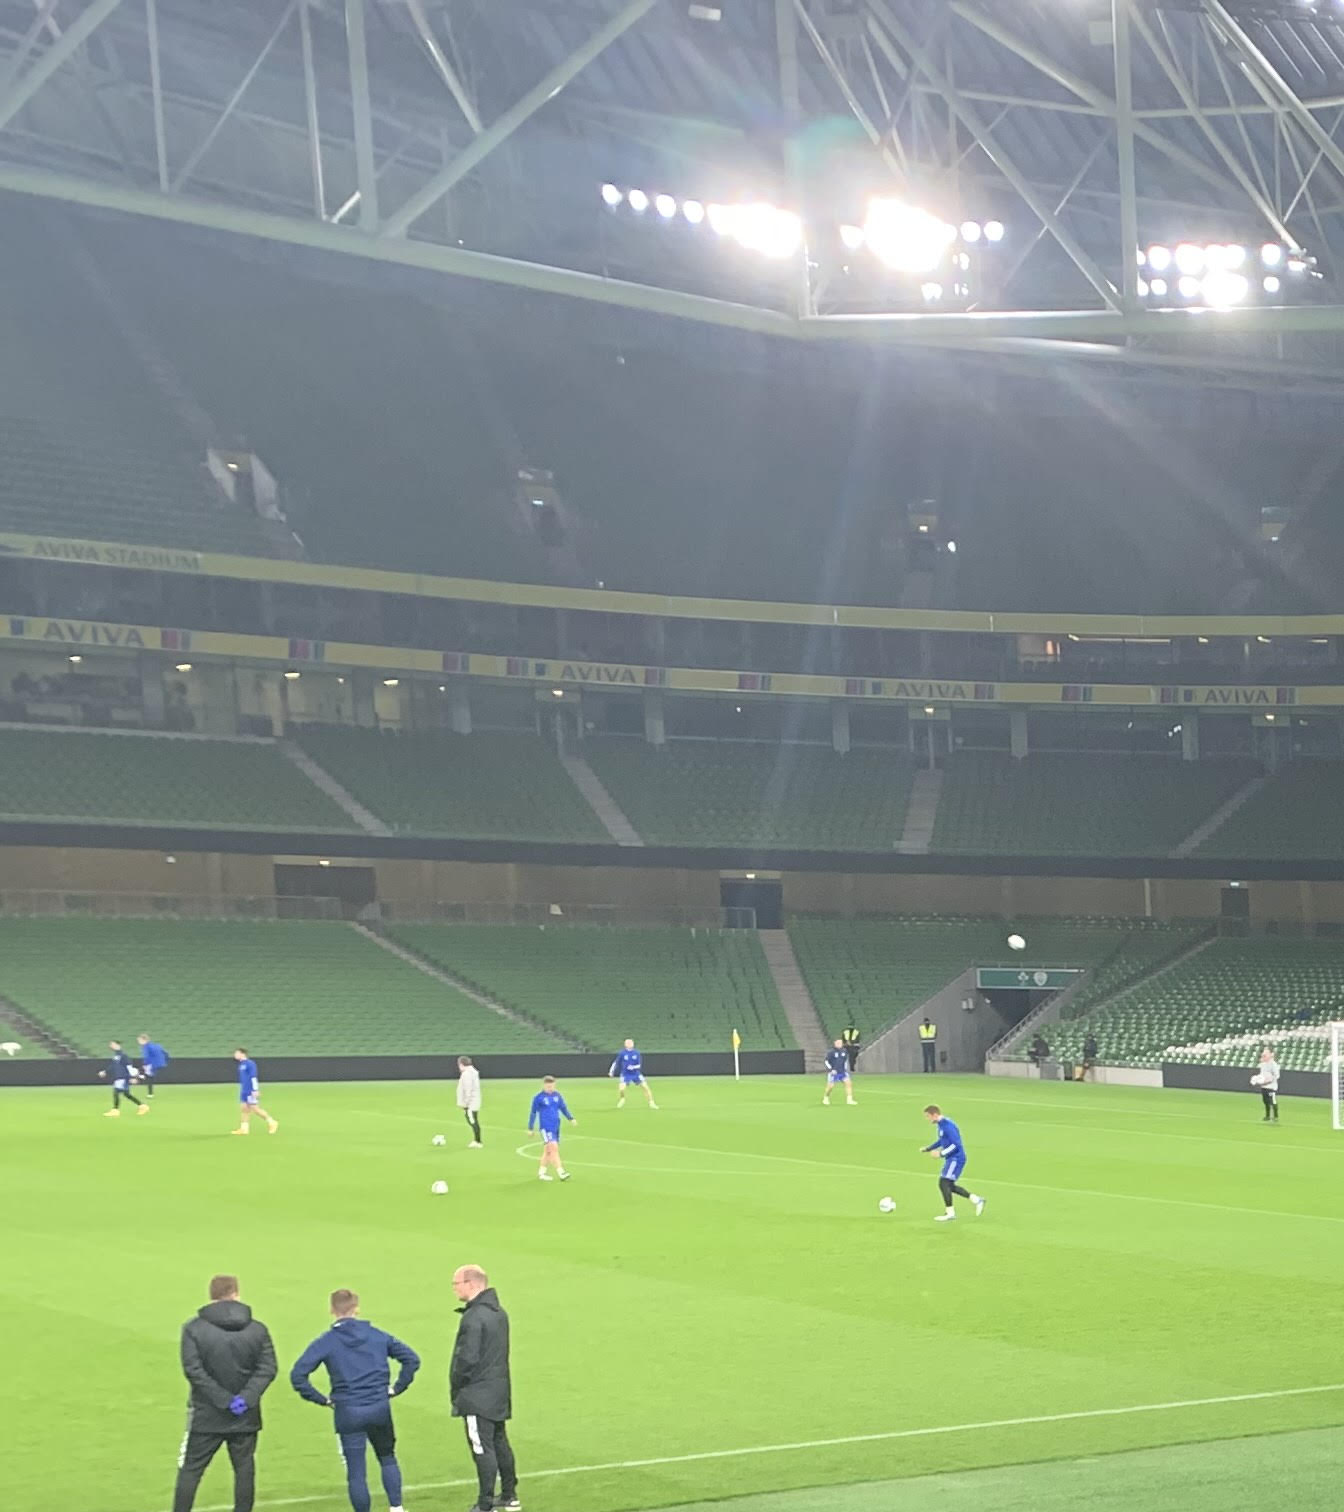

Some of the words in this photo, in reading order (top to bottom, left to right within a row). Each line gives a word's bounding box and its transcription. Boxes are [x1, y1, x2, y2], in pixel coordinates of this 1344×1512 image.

[33, 540, 99, 562] AVIVA
[103, 548, 200, 569] STADIUM
[44, 621, 145, 648] AVIVA
[560, 664, 637, 684] AVIVA
[896, 681, 966, 698] AVIVA
[1205, 688, 1270, 704] AVIVA
